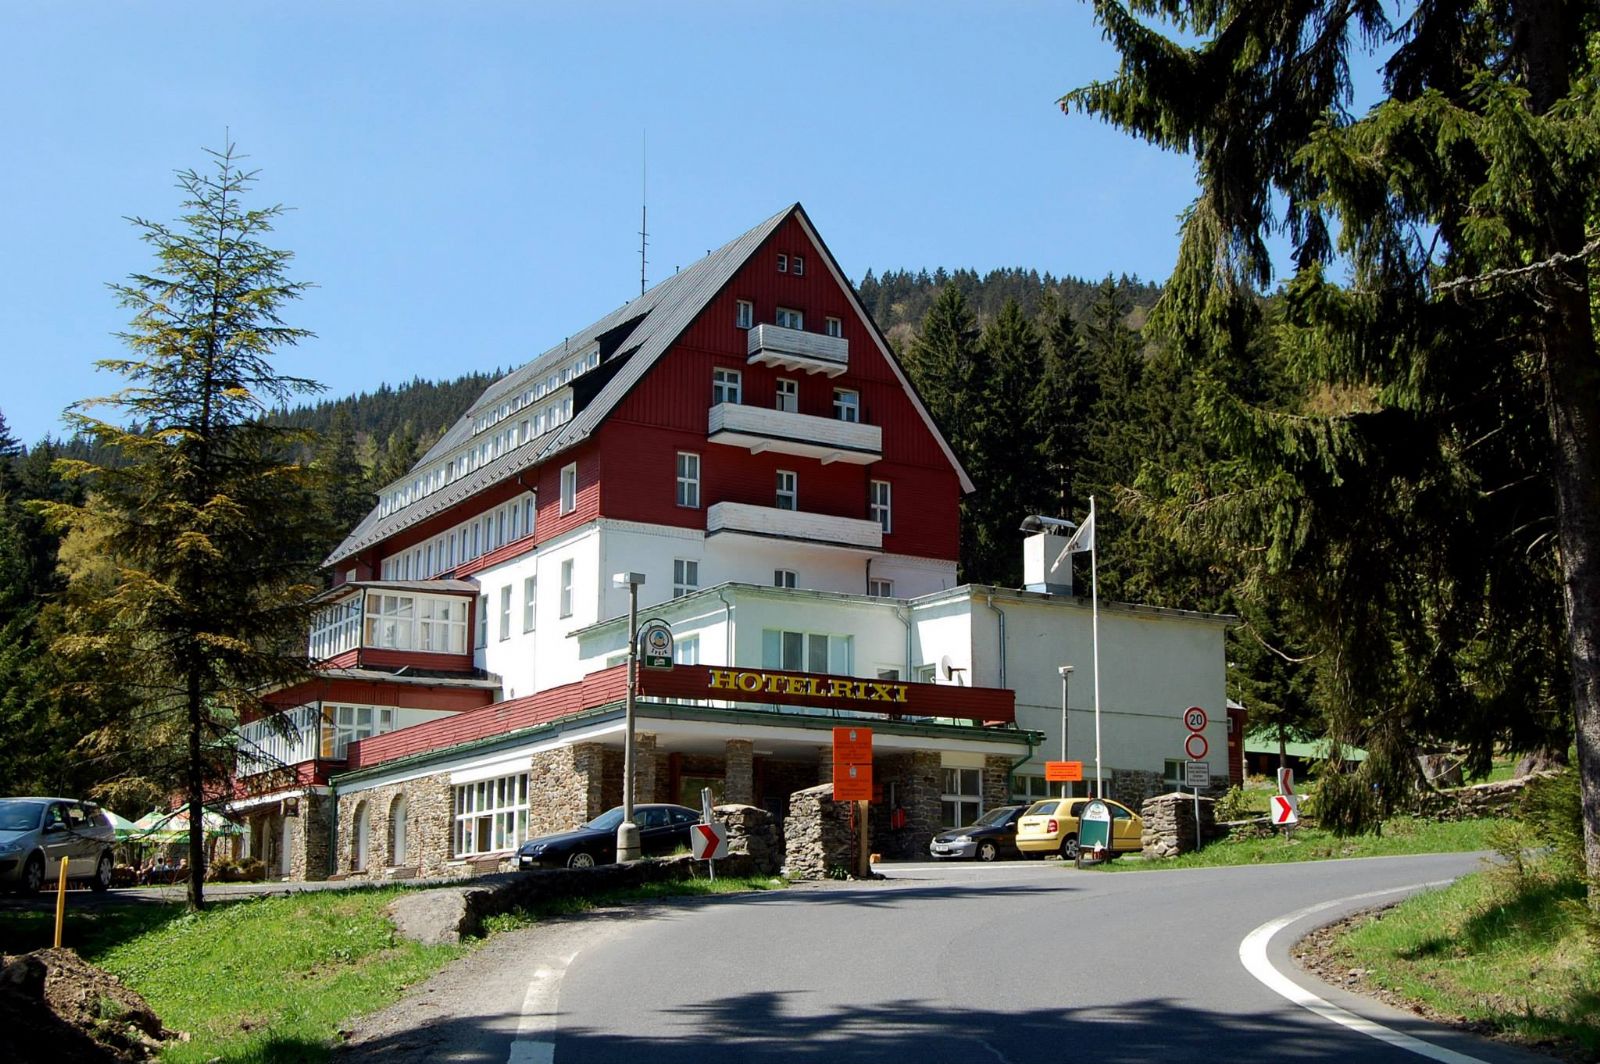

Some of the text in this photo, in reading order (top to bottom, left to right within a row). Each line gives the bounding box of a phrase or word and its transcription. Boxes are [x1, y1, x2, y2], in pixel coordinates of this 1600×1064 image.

[709, 669, 908, 702] HOTEL RIXI
[1190, 714, 1203, 726] 20
